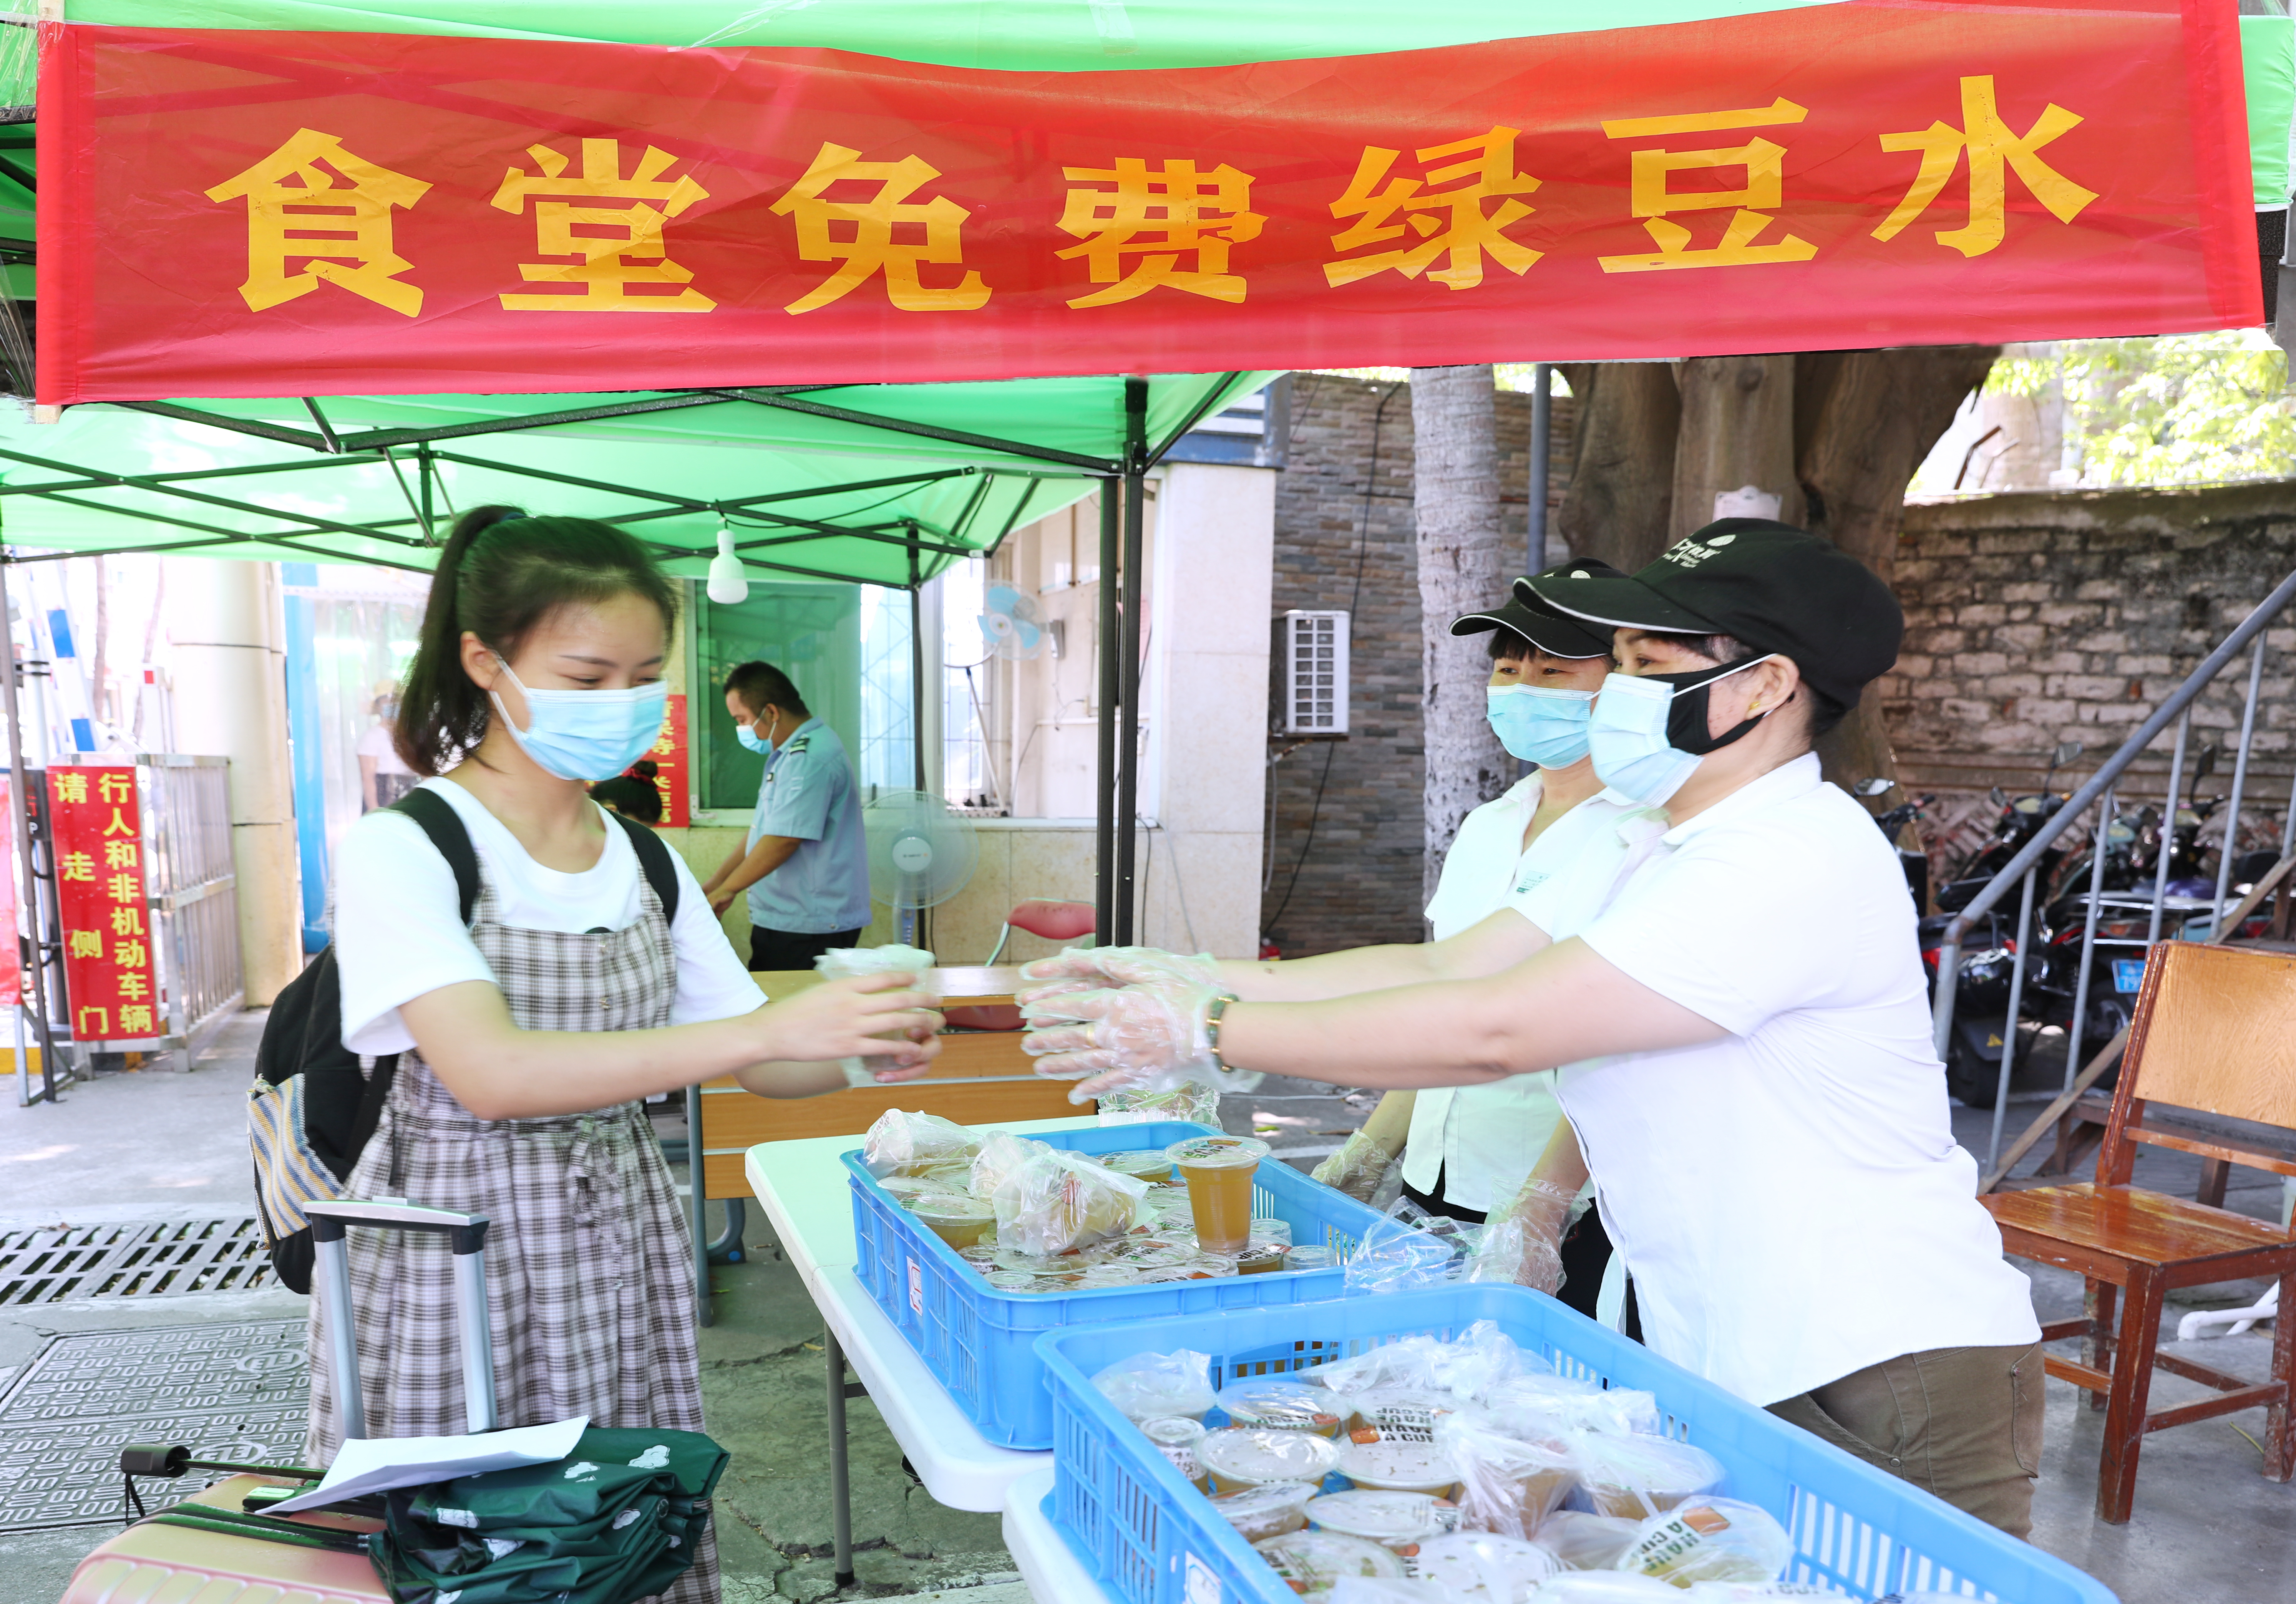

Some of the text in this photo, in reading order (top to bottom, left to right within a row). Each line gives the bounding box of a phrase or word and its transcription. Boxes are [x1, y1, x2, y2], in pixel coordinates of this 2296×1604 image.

[204, 75, 2099, 317] 食堂免费绿豆水
[54, 772, 109, 1034] 请走侧门
[98, 772, 153, 1034] 行人和非机动车辆
